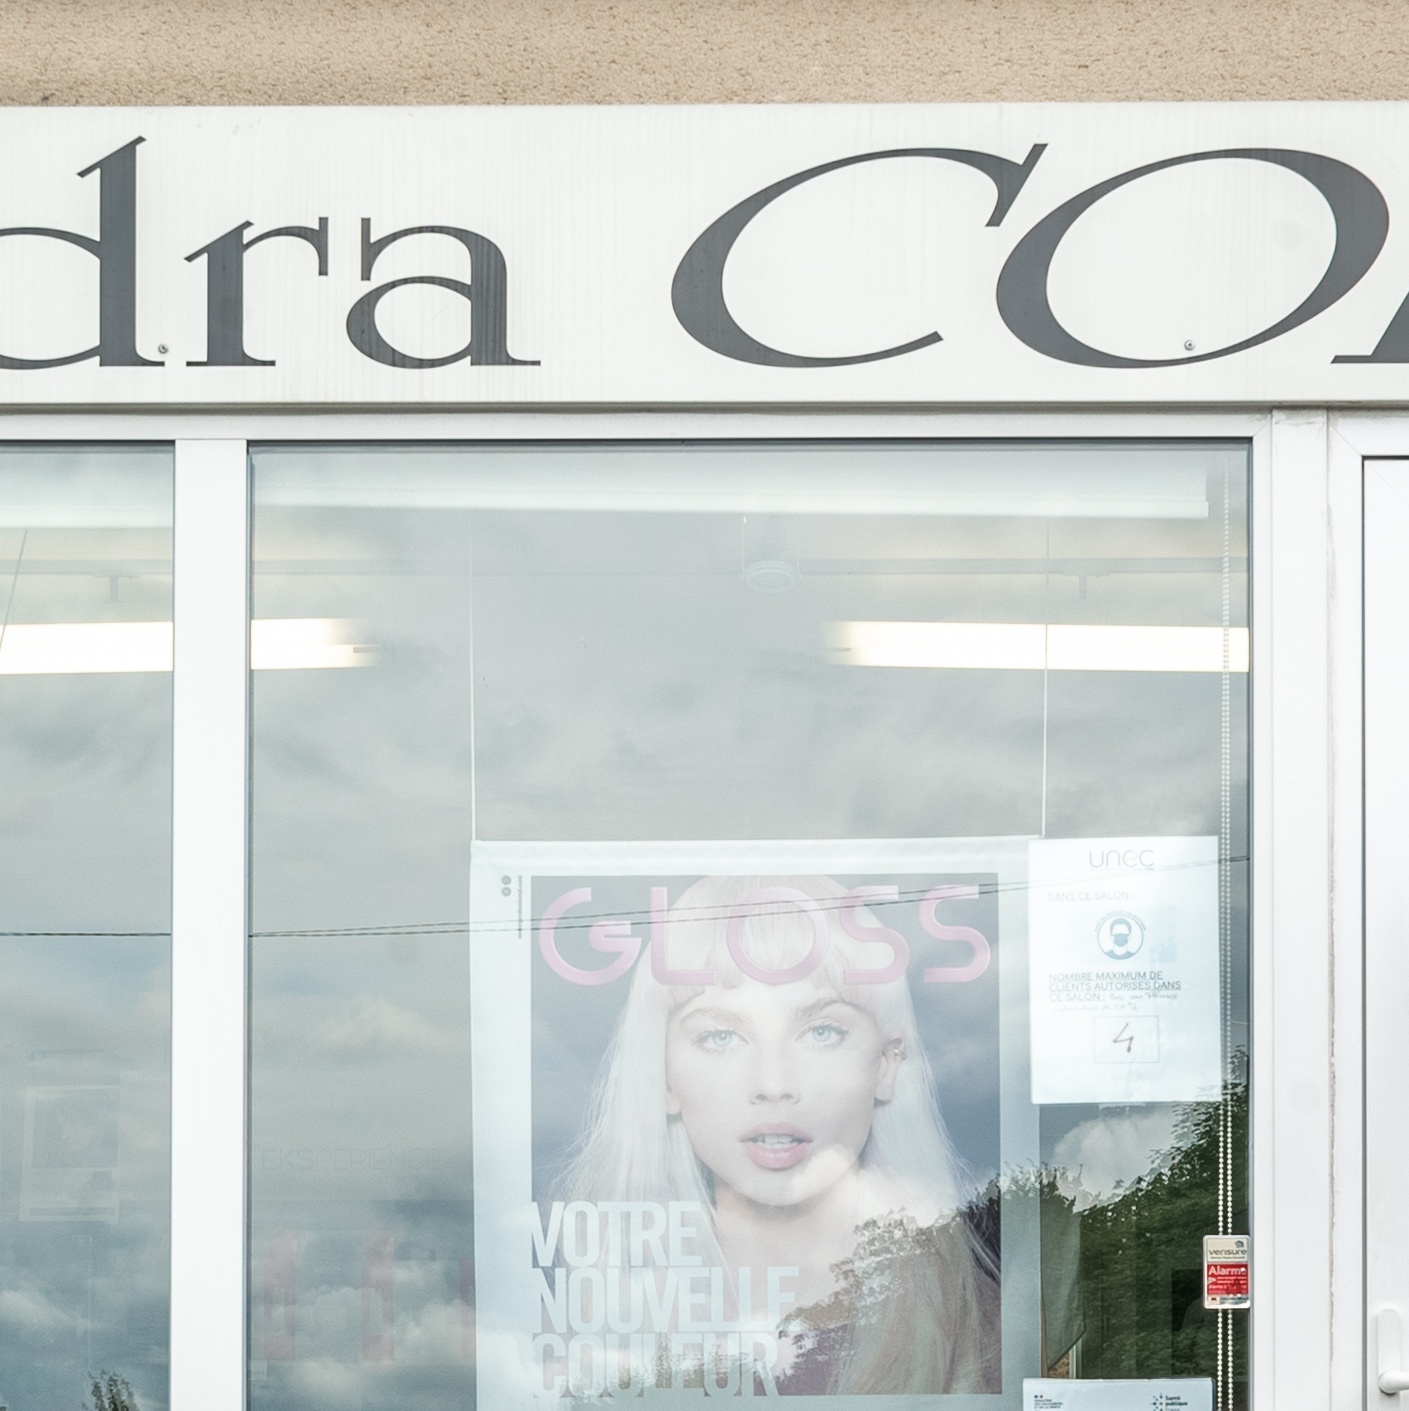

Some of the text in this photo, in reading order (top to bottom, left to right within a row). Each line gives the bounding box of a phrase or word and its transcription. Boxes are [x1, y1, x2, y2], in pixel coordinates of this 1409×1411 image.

[1048, 891, 1075, 901] DANS
[1078, 891, 1091, 900] CE
[539, 885, 991, 985] GLOSS
[1049, 971, 1163, 981] NOMBRE MAXIMUM DE
[1049, 982, 1092, 992] CLIENTS
[1153, 980, 1182, 990] DANS
[1049, 993, 1062, 1001] CE
[1112, 1022, 1134, 1053] 4
[530, 1201, 703, 1267] VOTRE
[531, 1266, 799, 1333] NOUVELLE
[532, 1332, 781, 1397] COULEUR
